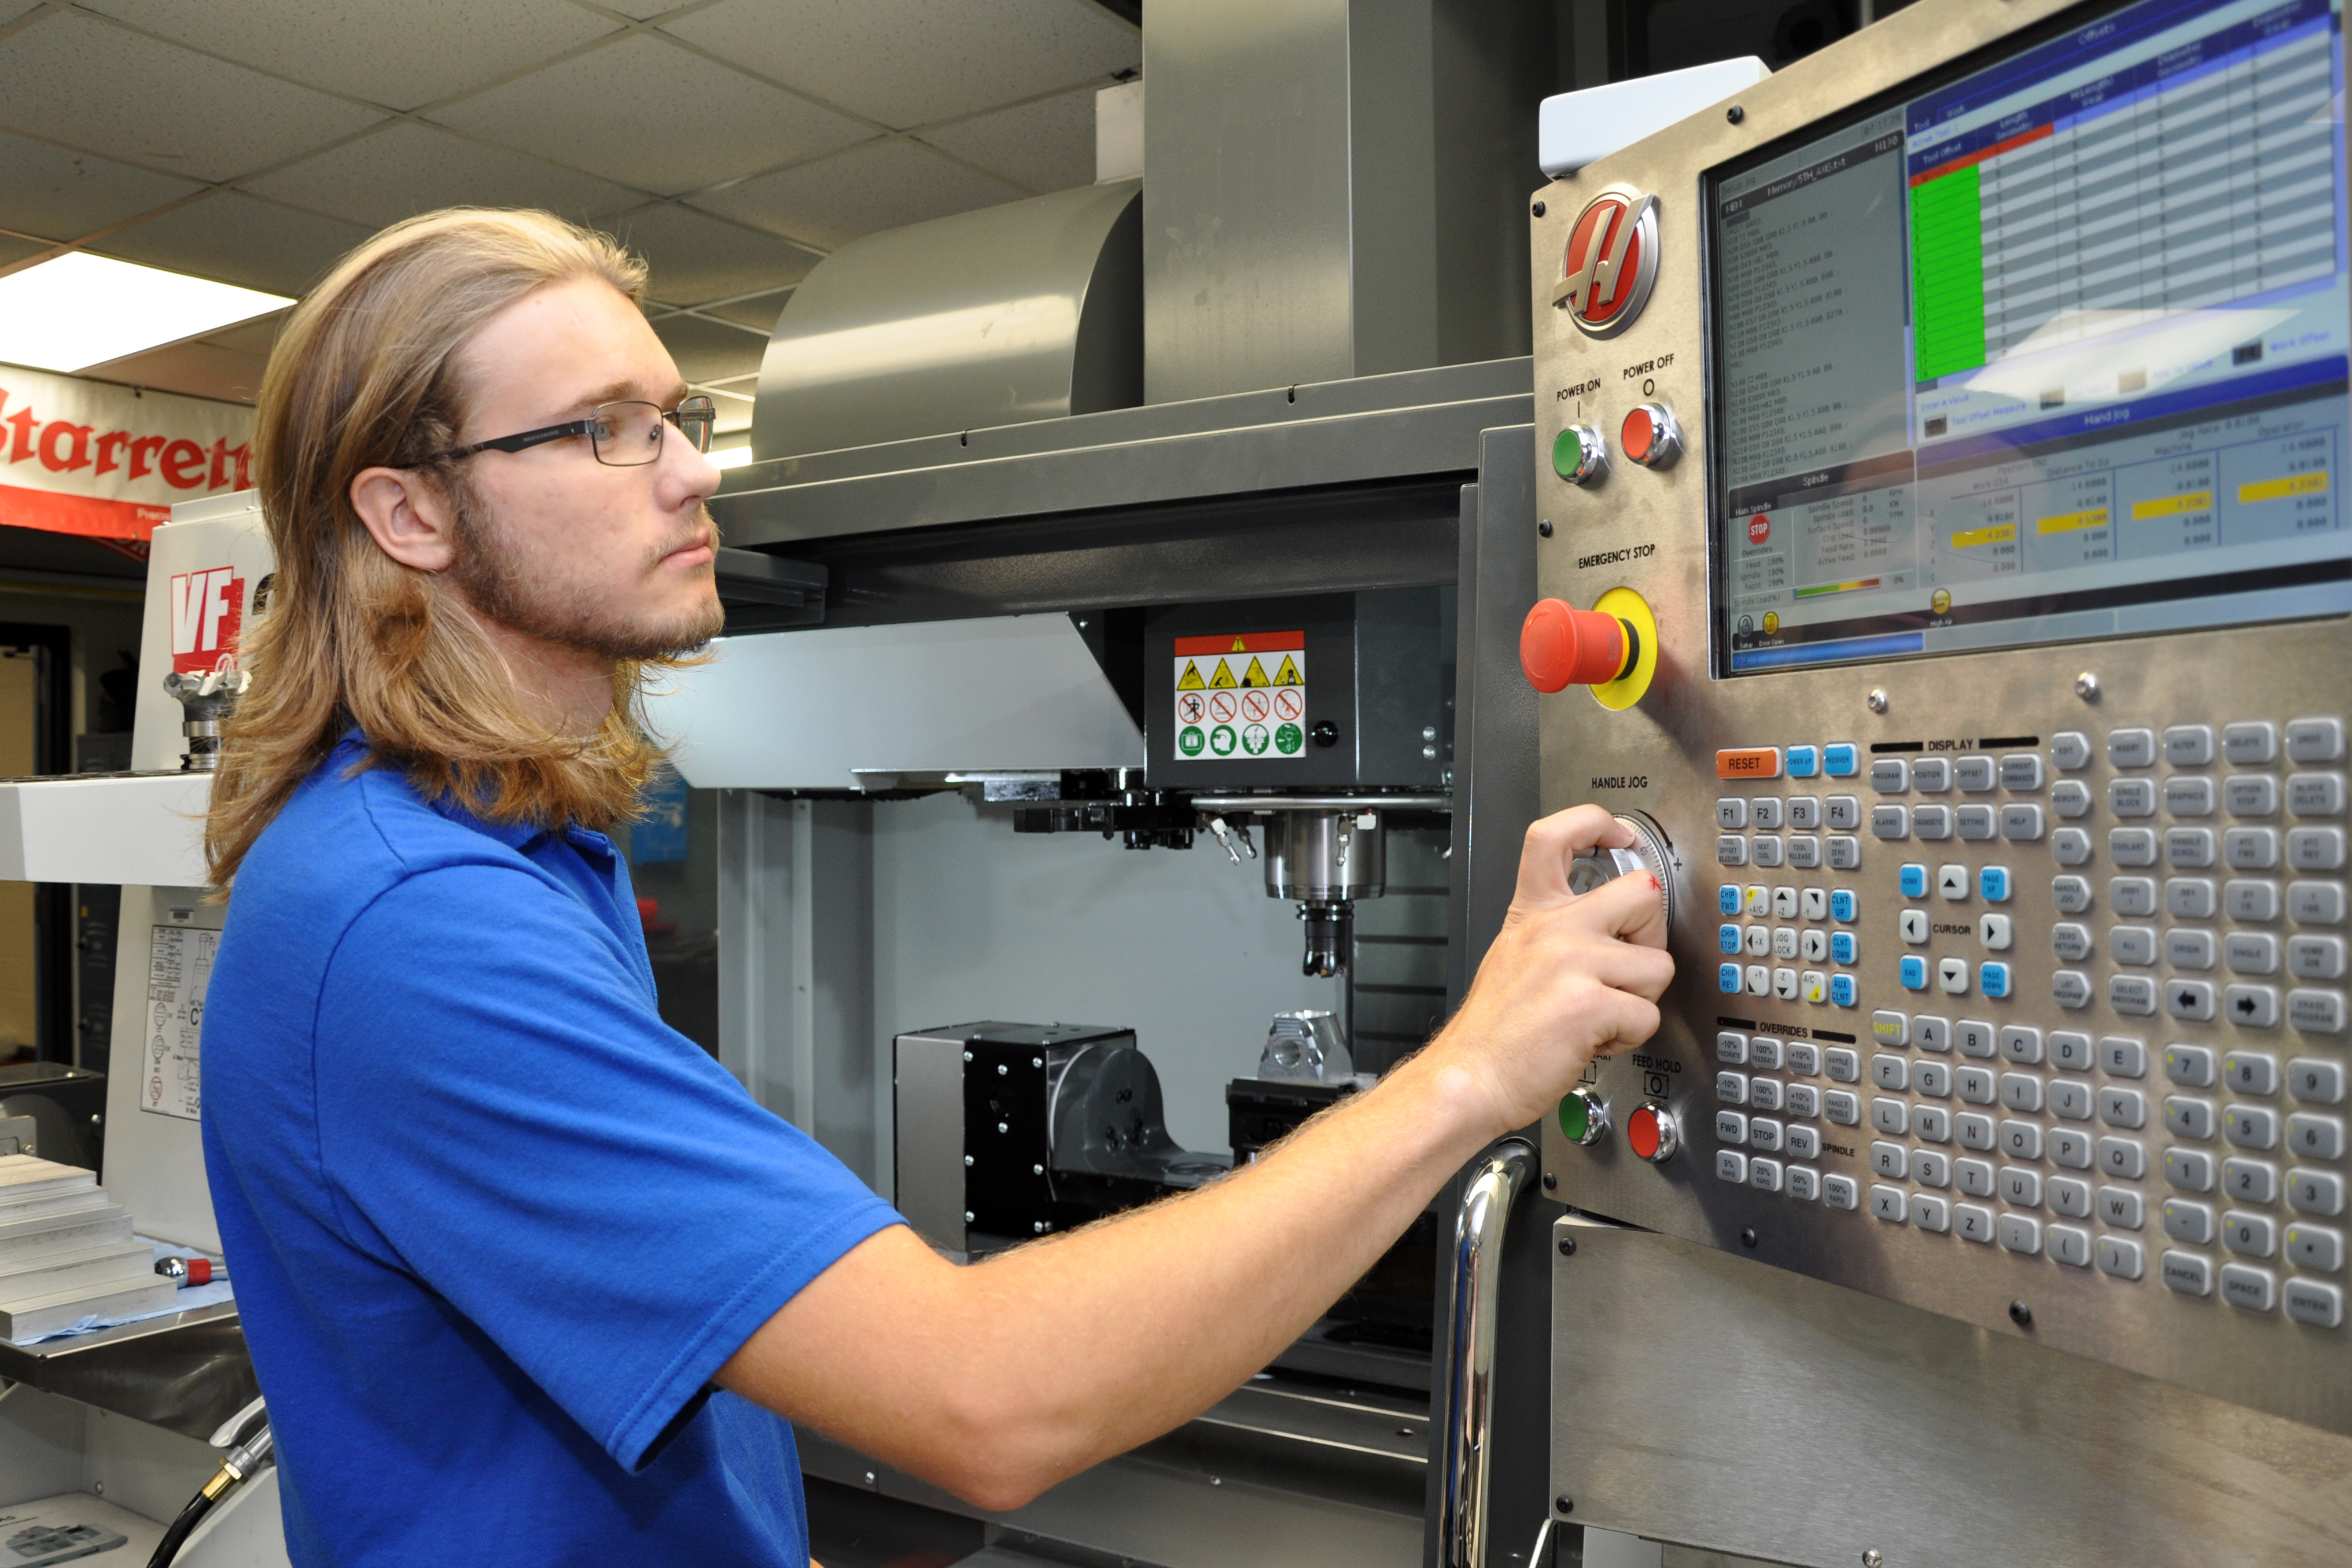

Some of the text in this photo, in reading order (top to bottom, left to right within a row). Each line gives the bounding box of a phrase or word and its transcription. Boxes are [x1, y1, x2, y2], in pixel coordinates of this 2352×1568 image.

[1624, 354, 1674, 380] POWER OFF
[1557, 378, 1600, 402] POWER ON
[1803, 474, 1829, 487] Spindle
[1736, 503, 1771, 516] Main Spindle
[1751, 523, 1768, 536] STOP
[1579, 544, 1655, 569] EMERGENCY STOP
[1742, 546, 1772, 557] Overrides
[1928, 739, 1973, 751] DISPLAY
[1729, 757, 1760, 770] RESET
[1592, 776, 1648, 788] HANDLE JOG
[1724, 809, 1733, 819] F1
[1757, 808, 1768, 819] F2
[1794, 808, 1805, 818] F3
[1831, 807, 1843, 818] F4
[1934, 925, 1971, 934] CURSOR
[1832, 992, 1849, 1000] CLNT
[1760, 1022, 1808, 1037] OVERRIDES
[1873, 1022, 1901, 1035] SHIFT
[1925, 1029, 1932, 1040] A
[1722, 1040, 1736, 1049] -10%
[1969, 1035, 1975, 1046] B
[2014, 1040, 2022, 1052] C
[1718, 1050, 1740, 1059] FEEDRATE
[1755, 1046, 1772, 1054] 100%
[1792, 1051, 1809, 1060] +10%
[2063, 1046, 2071, 1058] D
[1753, 1055, 1776, 1065] FEEDRATE
[2115, 1051, 2122, 1064] E
[1633, 1054, 1681, 1073] FEED HOLD
[2182, 1059, 2190, 1072] 7
[1884, 1068, 1889, 1079] F
[2242, 1068, 2250, 1081] 8
[1925, 1074, 1933, 1085] G
[2307, 1075, 2316, 1089] 9
[1755, 1085, 1772, 1095] 100%
[1969, 1081, 1976, 1092] H
[1720, 1089, 1738, 1098] SPINDLE
[1791, 1093, 1809, 1102] +10%
[1754, 1096, 1773, 1105] SPINDLE
[2064, 1095, 2071, 1106] J
[1790, 1102, 1810, 1111] SPINDLE
[2114, 1102, 2122, 1115] K
[1883, 1112, 1889, 1123] L
[2181, 1113, 2190, 1125] 4
[1721, 1123, 1738, 1134] FWD
[1924, 1119, 1933, 1131] M
[2242, 1121, 2250, 1134] 5
[1753, 1130, 1774, 1141] STOP
[1968, 1127, 1976, 1138] N
[2307, 1130, 2316, 1144] 6
[1791, 1138, 1807, 1149] REV
[2063, 1142, 2070, 1155] P
[1823, 1143, 1854, 1157] SPINDLE
[1882, 1155, 1889, 1167] R
[2113, 1151, 2123, 1165] Q
[1724, 1160, 1733, 1169] 5%
[1924, 1164, 1931, 1175] S
[1757, 1166, 1770, 1176] 25%
[2182, 1164, 2189, 1177] 1
[1792, 1175, 1806, 1185] 50%
[1968, 1173, 1975, 1184] T
[2241, 1175, 2250, 1188] 2
[1828, 1184, 1846, 1194] 100%
[2014, 1181, 2021, 1193] U
[2062, 1191, 2070, 1204] V
[2306, 1186, 2315, 1200] 3
[1882, 1199, 1889, 1210] X
[2111, 1201, 2123, 1215] W
[1924, 1209, 1930, 1220] Y
[1967, 1219, 1974, 1231] Z
[2241, 1228, 2249, 1242] 0
